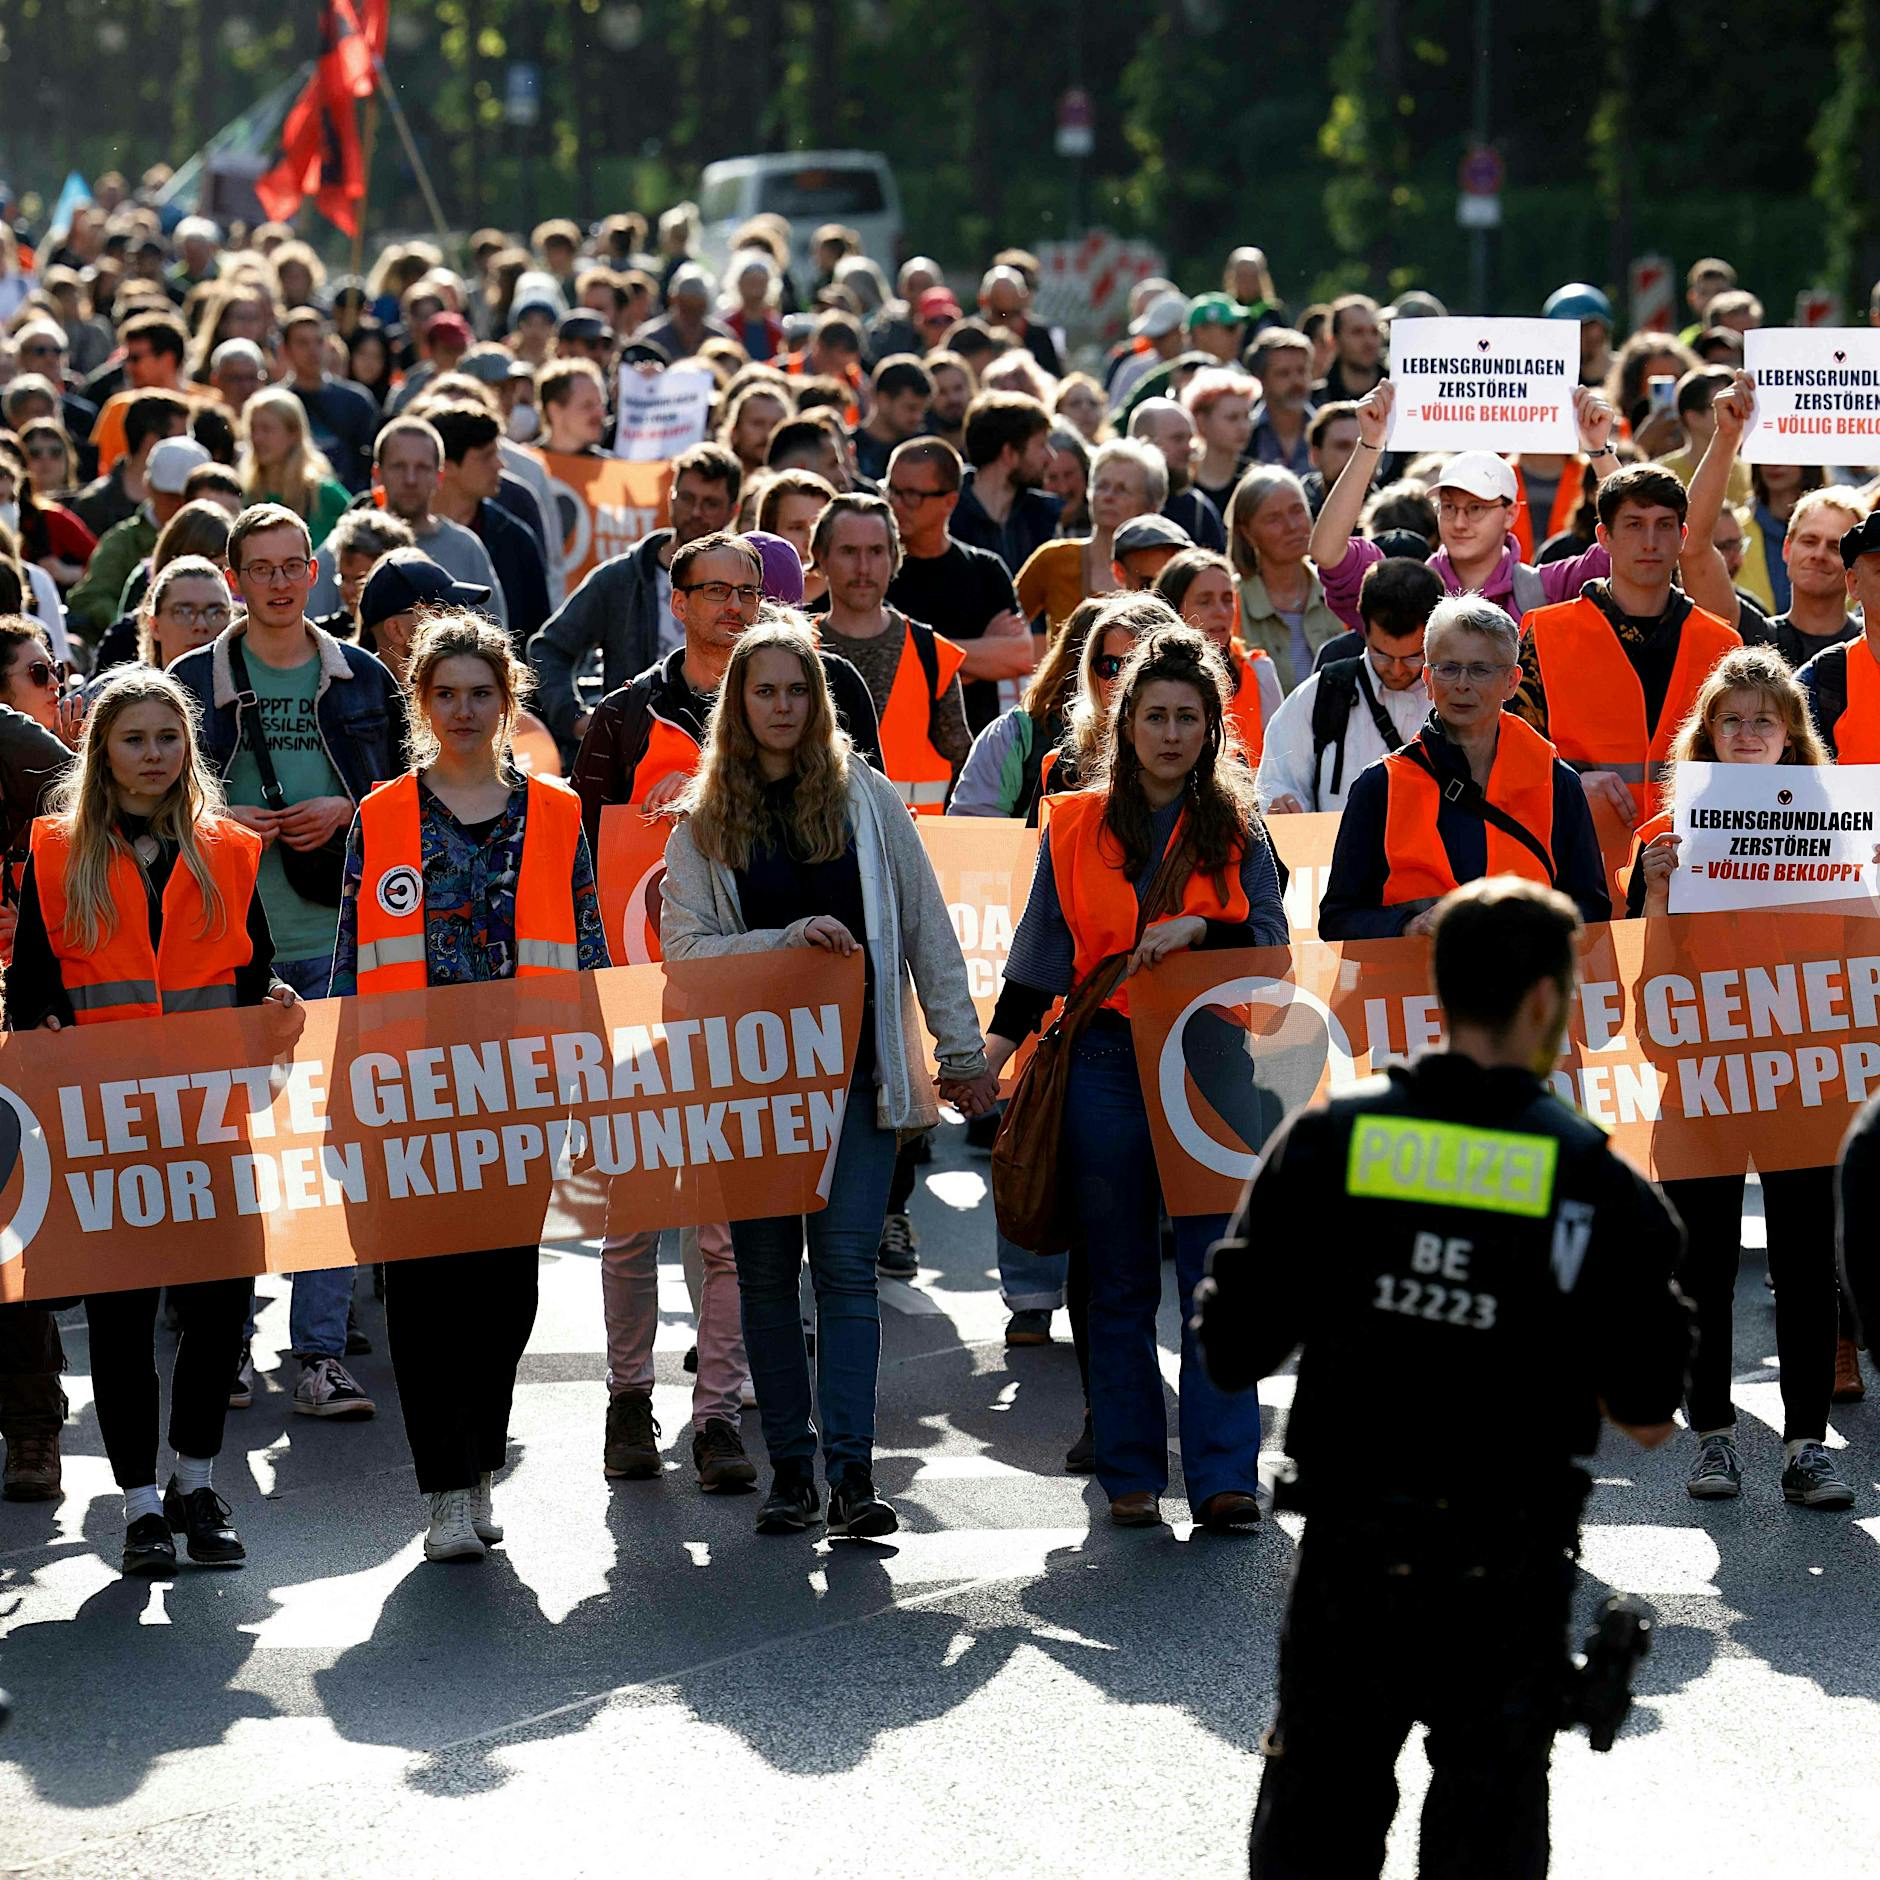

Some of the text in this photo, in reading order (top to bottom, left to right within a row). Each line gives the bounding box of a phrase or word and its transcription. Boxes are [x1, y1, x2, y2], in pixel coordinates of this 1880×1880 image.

[1402, 357, 1565, 376] LEBENSGRUNDLAGEN
[1757, 369, 1880, 387] LEBENSGRUNDL
[1438, 379, 1528, 398] ZERSTÖREN
[1407, 402, 1560, 423] = VÖLLIG BEKLOPPT
[1762, 421, 1774, 430] =
[1777, 414, 1832, 434] VÖLLIG
[257, 698, 294, 715] PPT
[1690, 808, 1873, 831] LEBENSGRUNDLAGEN
[1728, 835, 1831, 857] ZERSTÖREN
[1691, 859, 1864, 883] = VÖLLIG BEKLOPPT
[1363, 956, 1880, 1070] LEE GENER
[57, 1003, 845, 1159] LETZTE GENERATION
[1676, 1042, 1880, 1120] KIPPP
[64, 1088, 845, 1233] VOR DEN KIPPPUNKTEN
[1358, 1127, 1547, 1204] POLIZEI
[1410, 1230, 1474, 1282] BE
[1372, 1273, 1498, 1330] 12223
